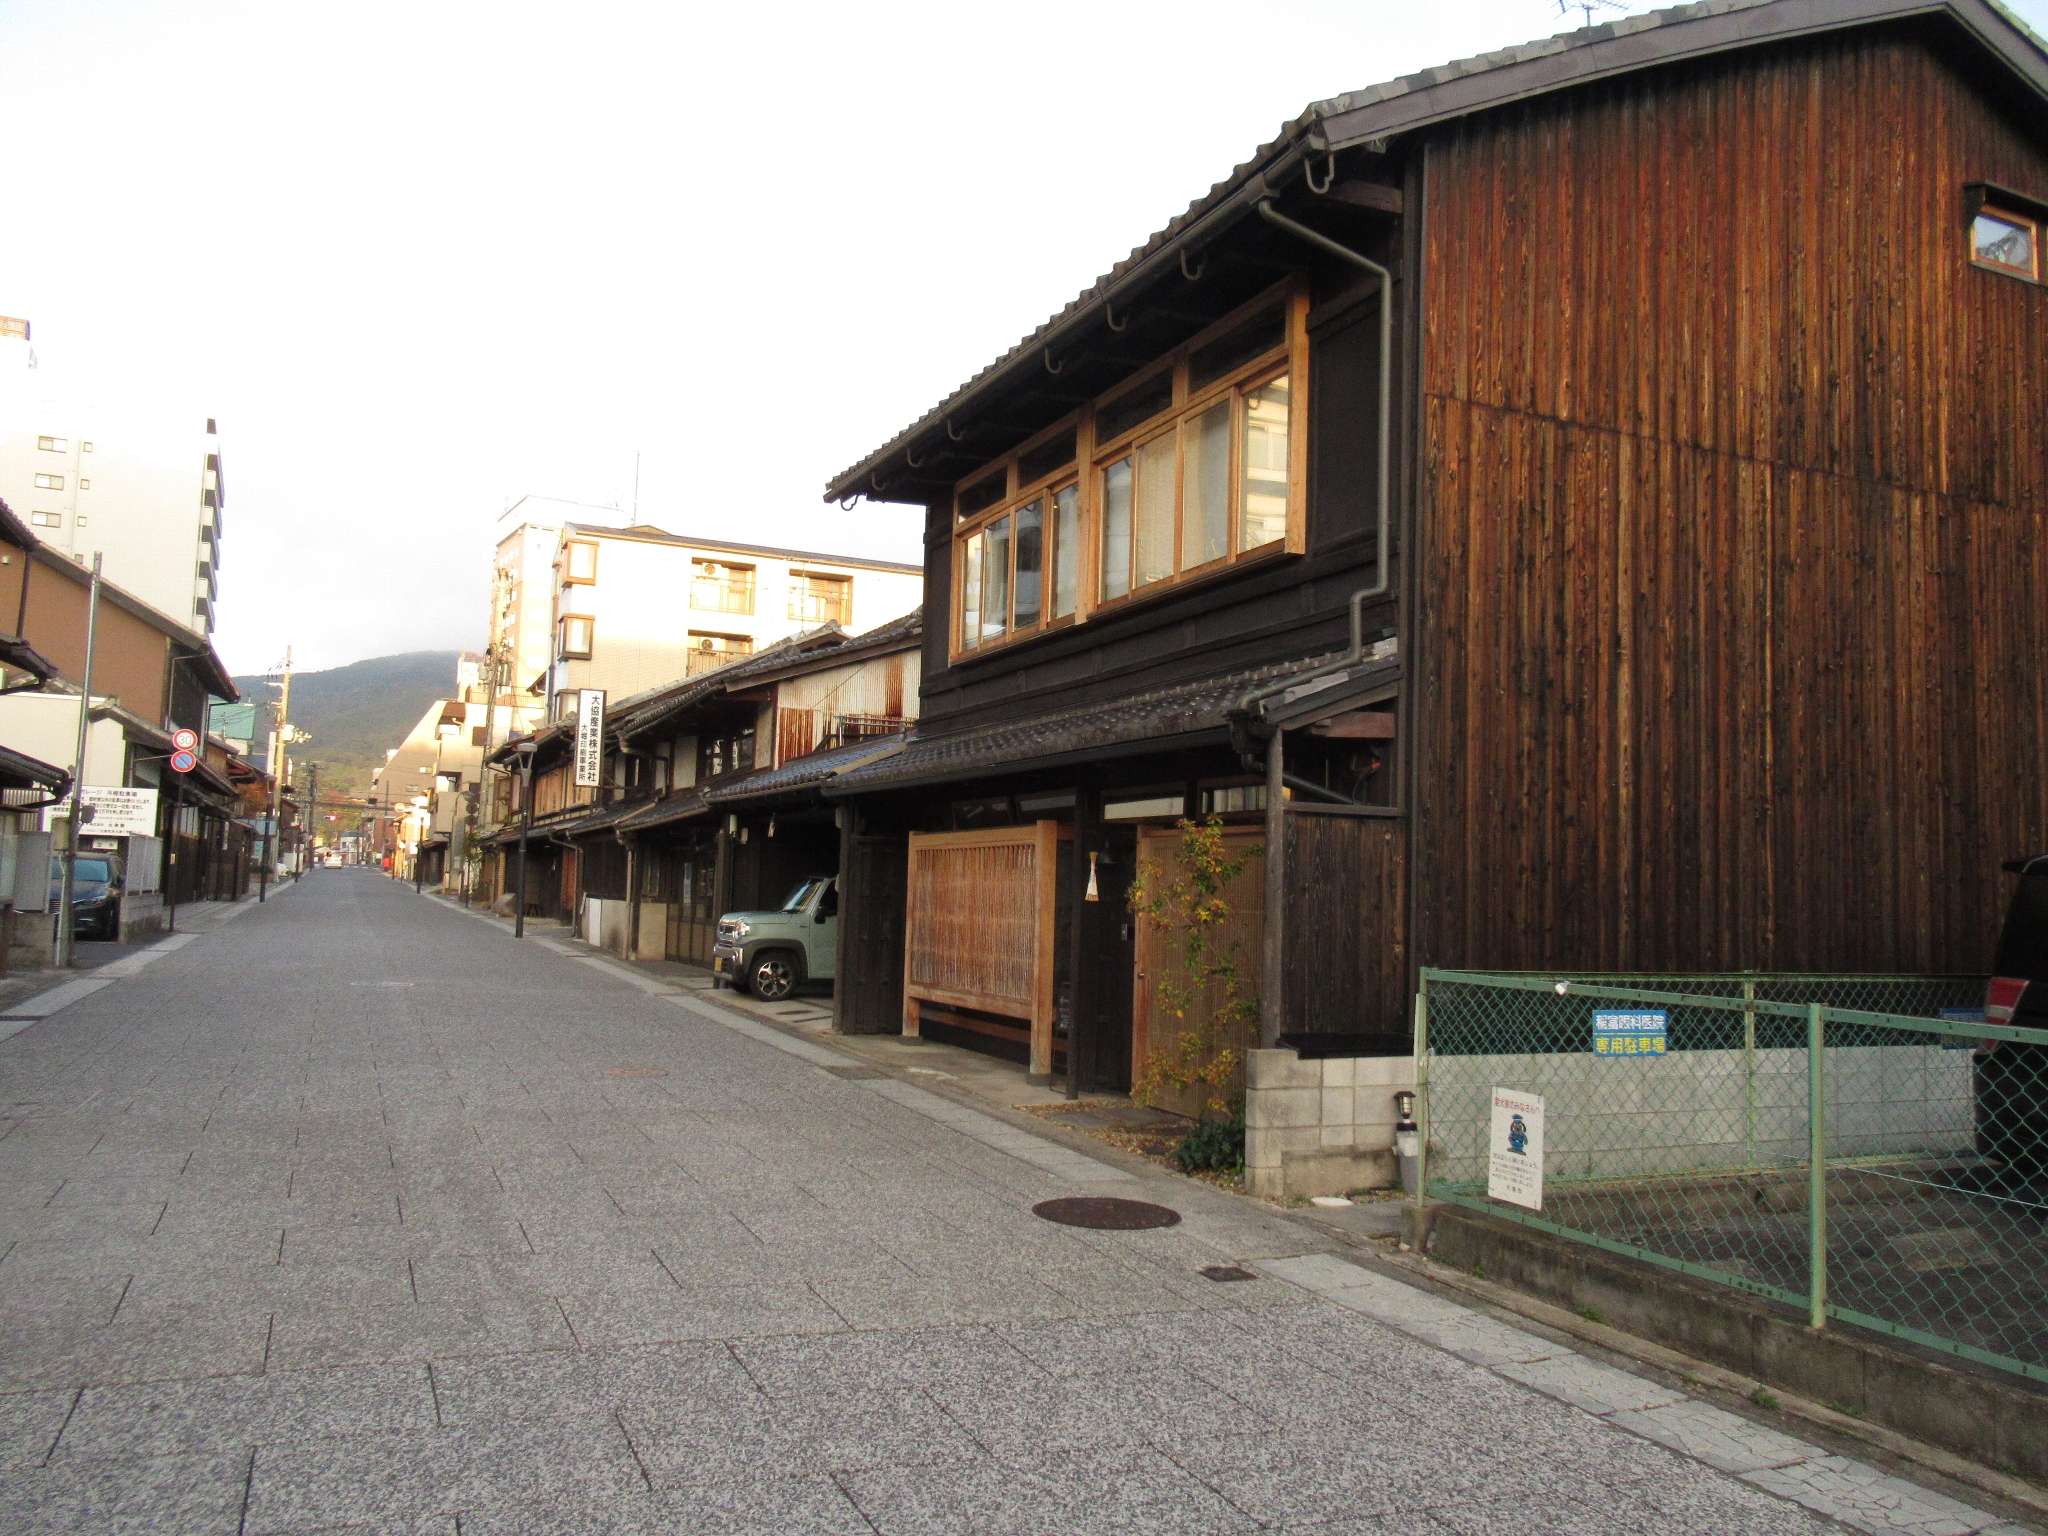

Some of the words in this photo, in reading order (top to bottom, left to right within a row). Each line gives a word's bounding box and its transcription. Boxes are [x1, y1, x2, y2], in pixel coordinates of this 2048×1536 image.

[178, 735, 192, 745] 30
[587, 694, 600, 782] 大協産業株式会社
[1596, 1037, 1665, 1054] 専用駐車場
